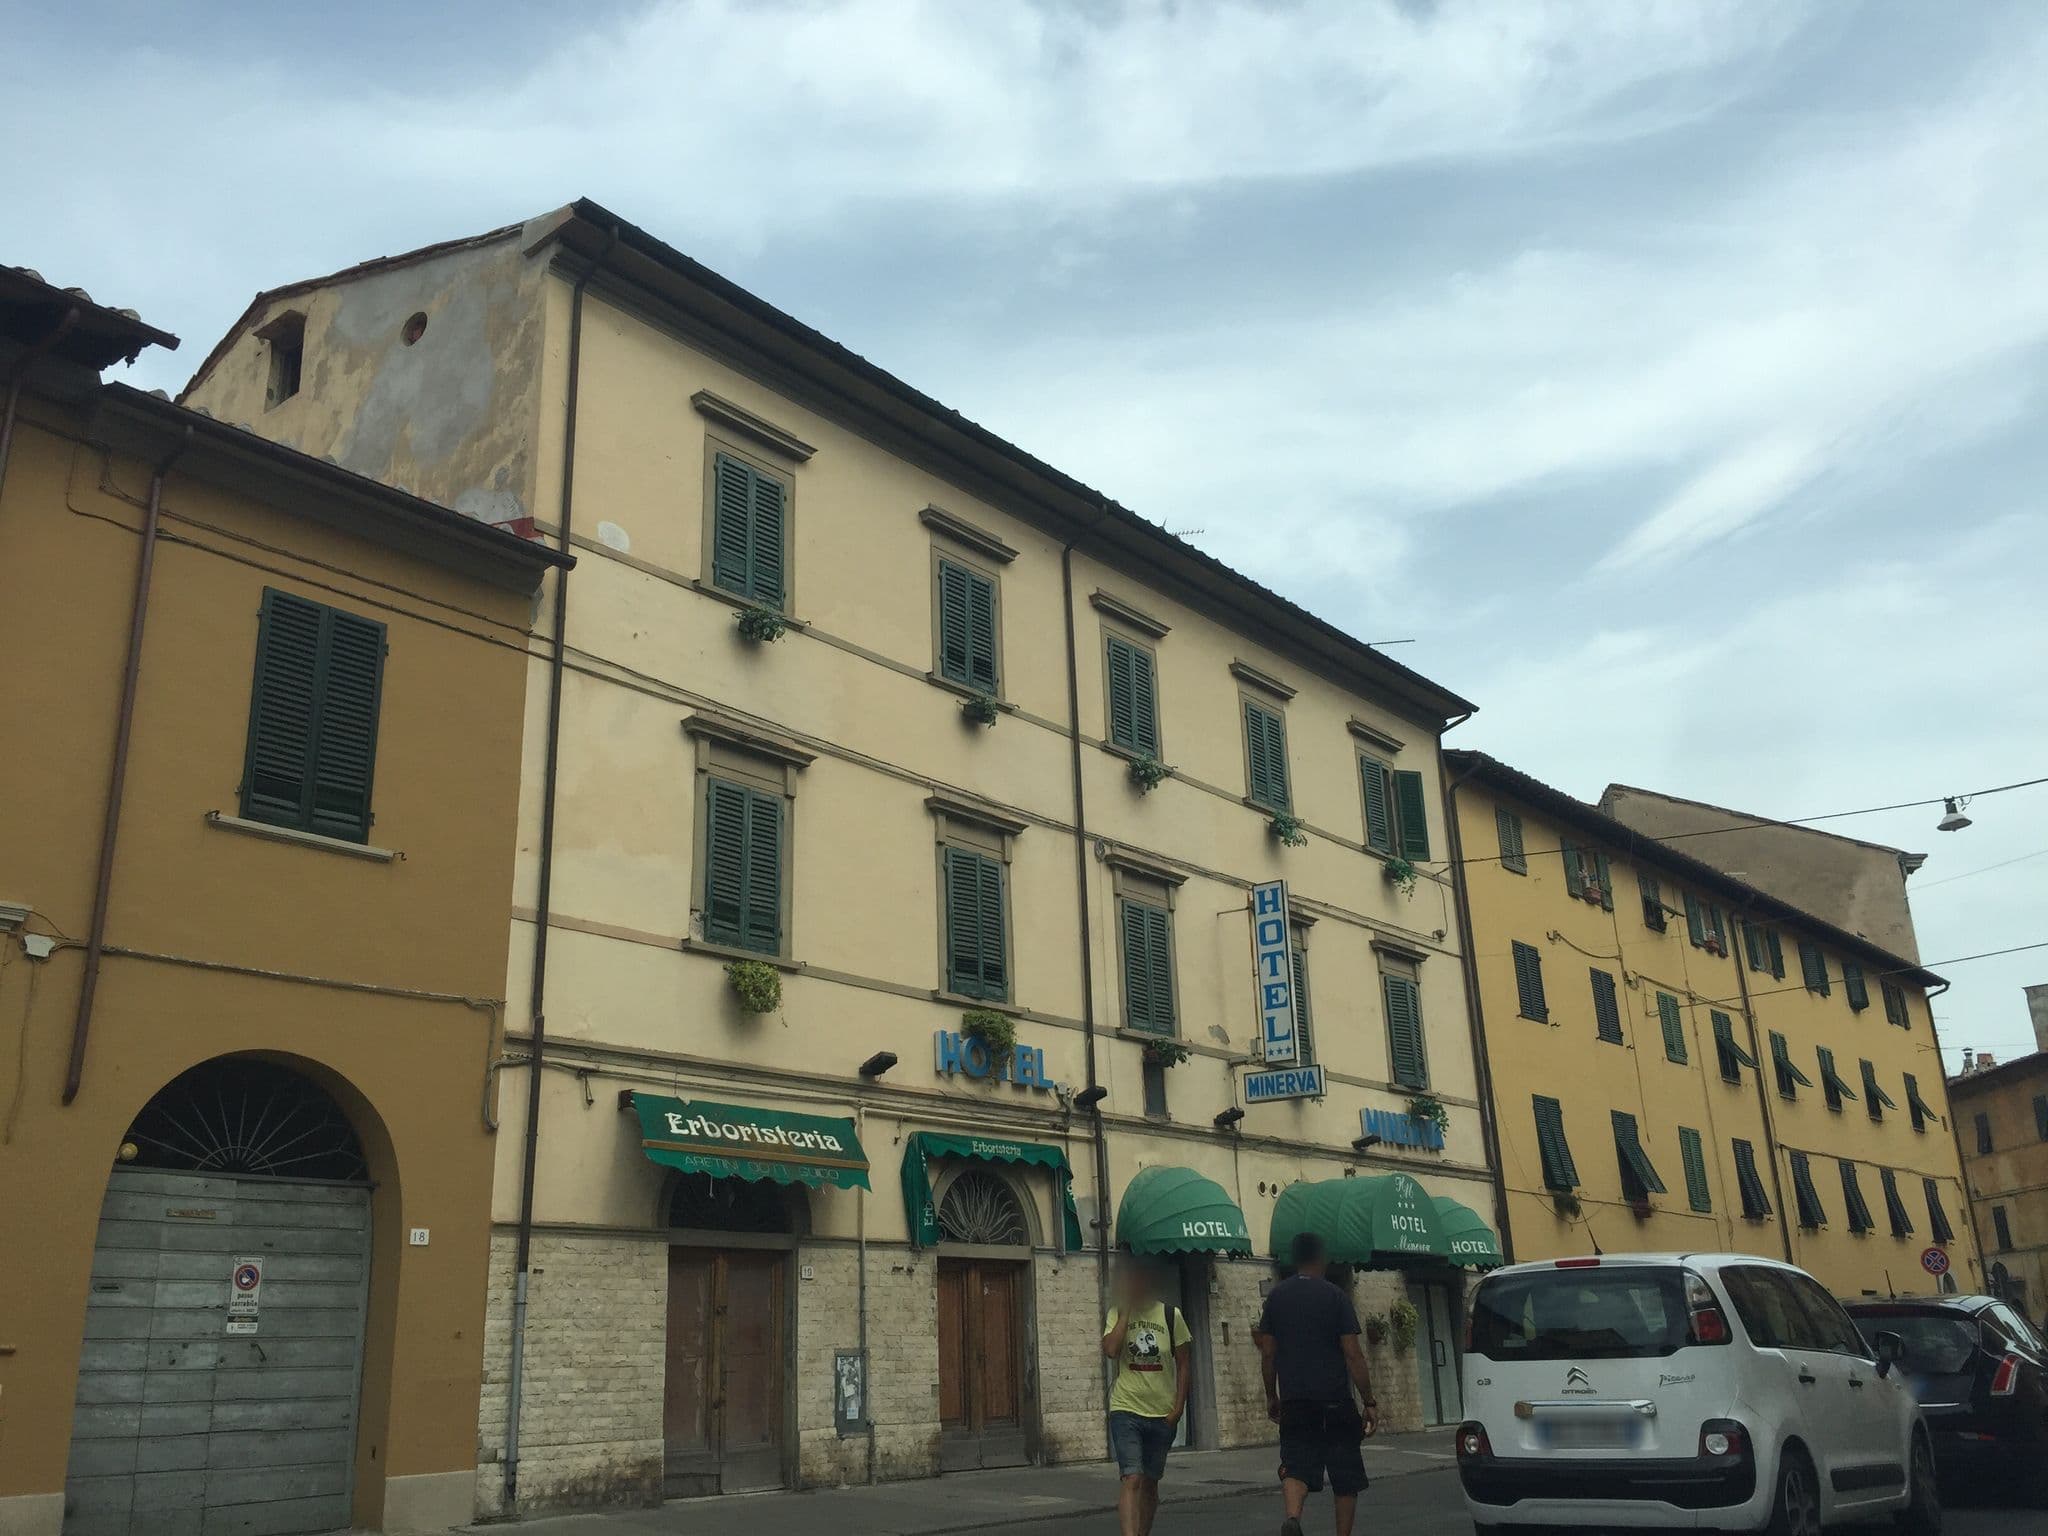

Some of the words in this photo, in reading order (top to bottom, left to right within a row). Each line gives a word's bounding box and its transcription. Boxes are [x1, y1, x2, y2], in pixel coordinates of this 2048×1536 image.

[1256, 886, 1292, 1043] HOTEL
[1248, 1070, 1318, 1098] MINERVA
[665, 1112, 843, 1152] Erboristeria
[972, 1140, 1022, 1157] Erboristeria
[1182, 1221, 1232, 1237] HOTEL
[1391, 1214, 1427, 1234] HOTEL
[413, 1231, 425, 1242] 18
[1451, 1240, 1491, 1254] HOTEL
